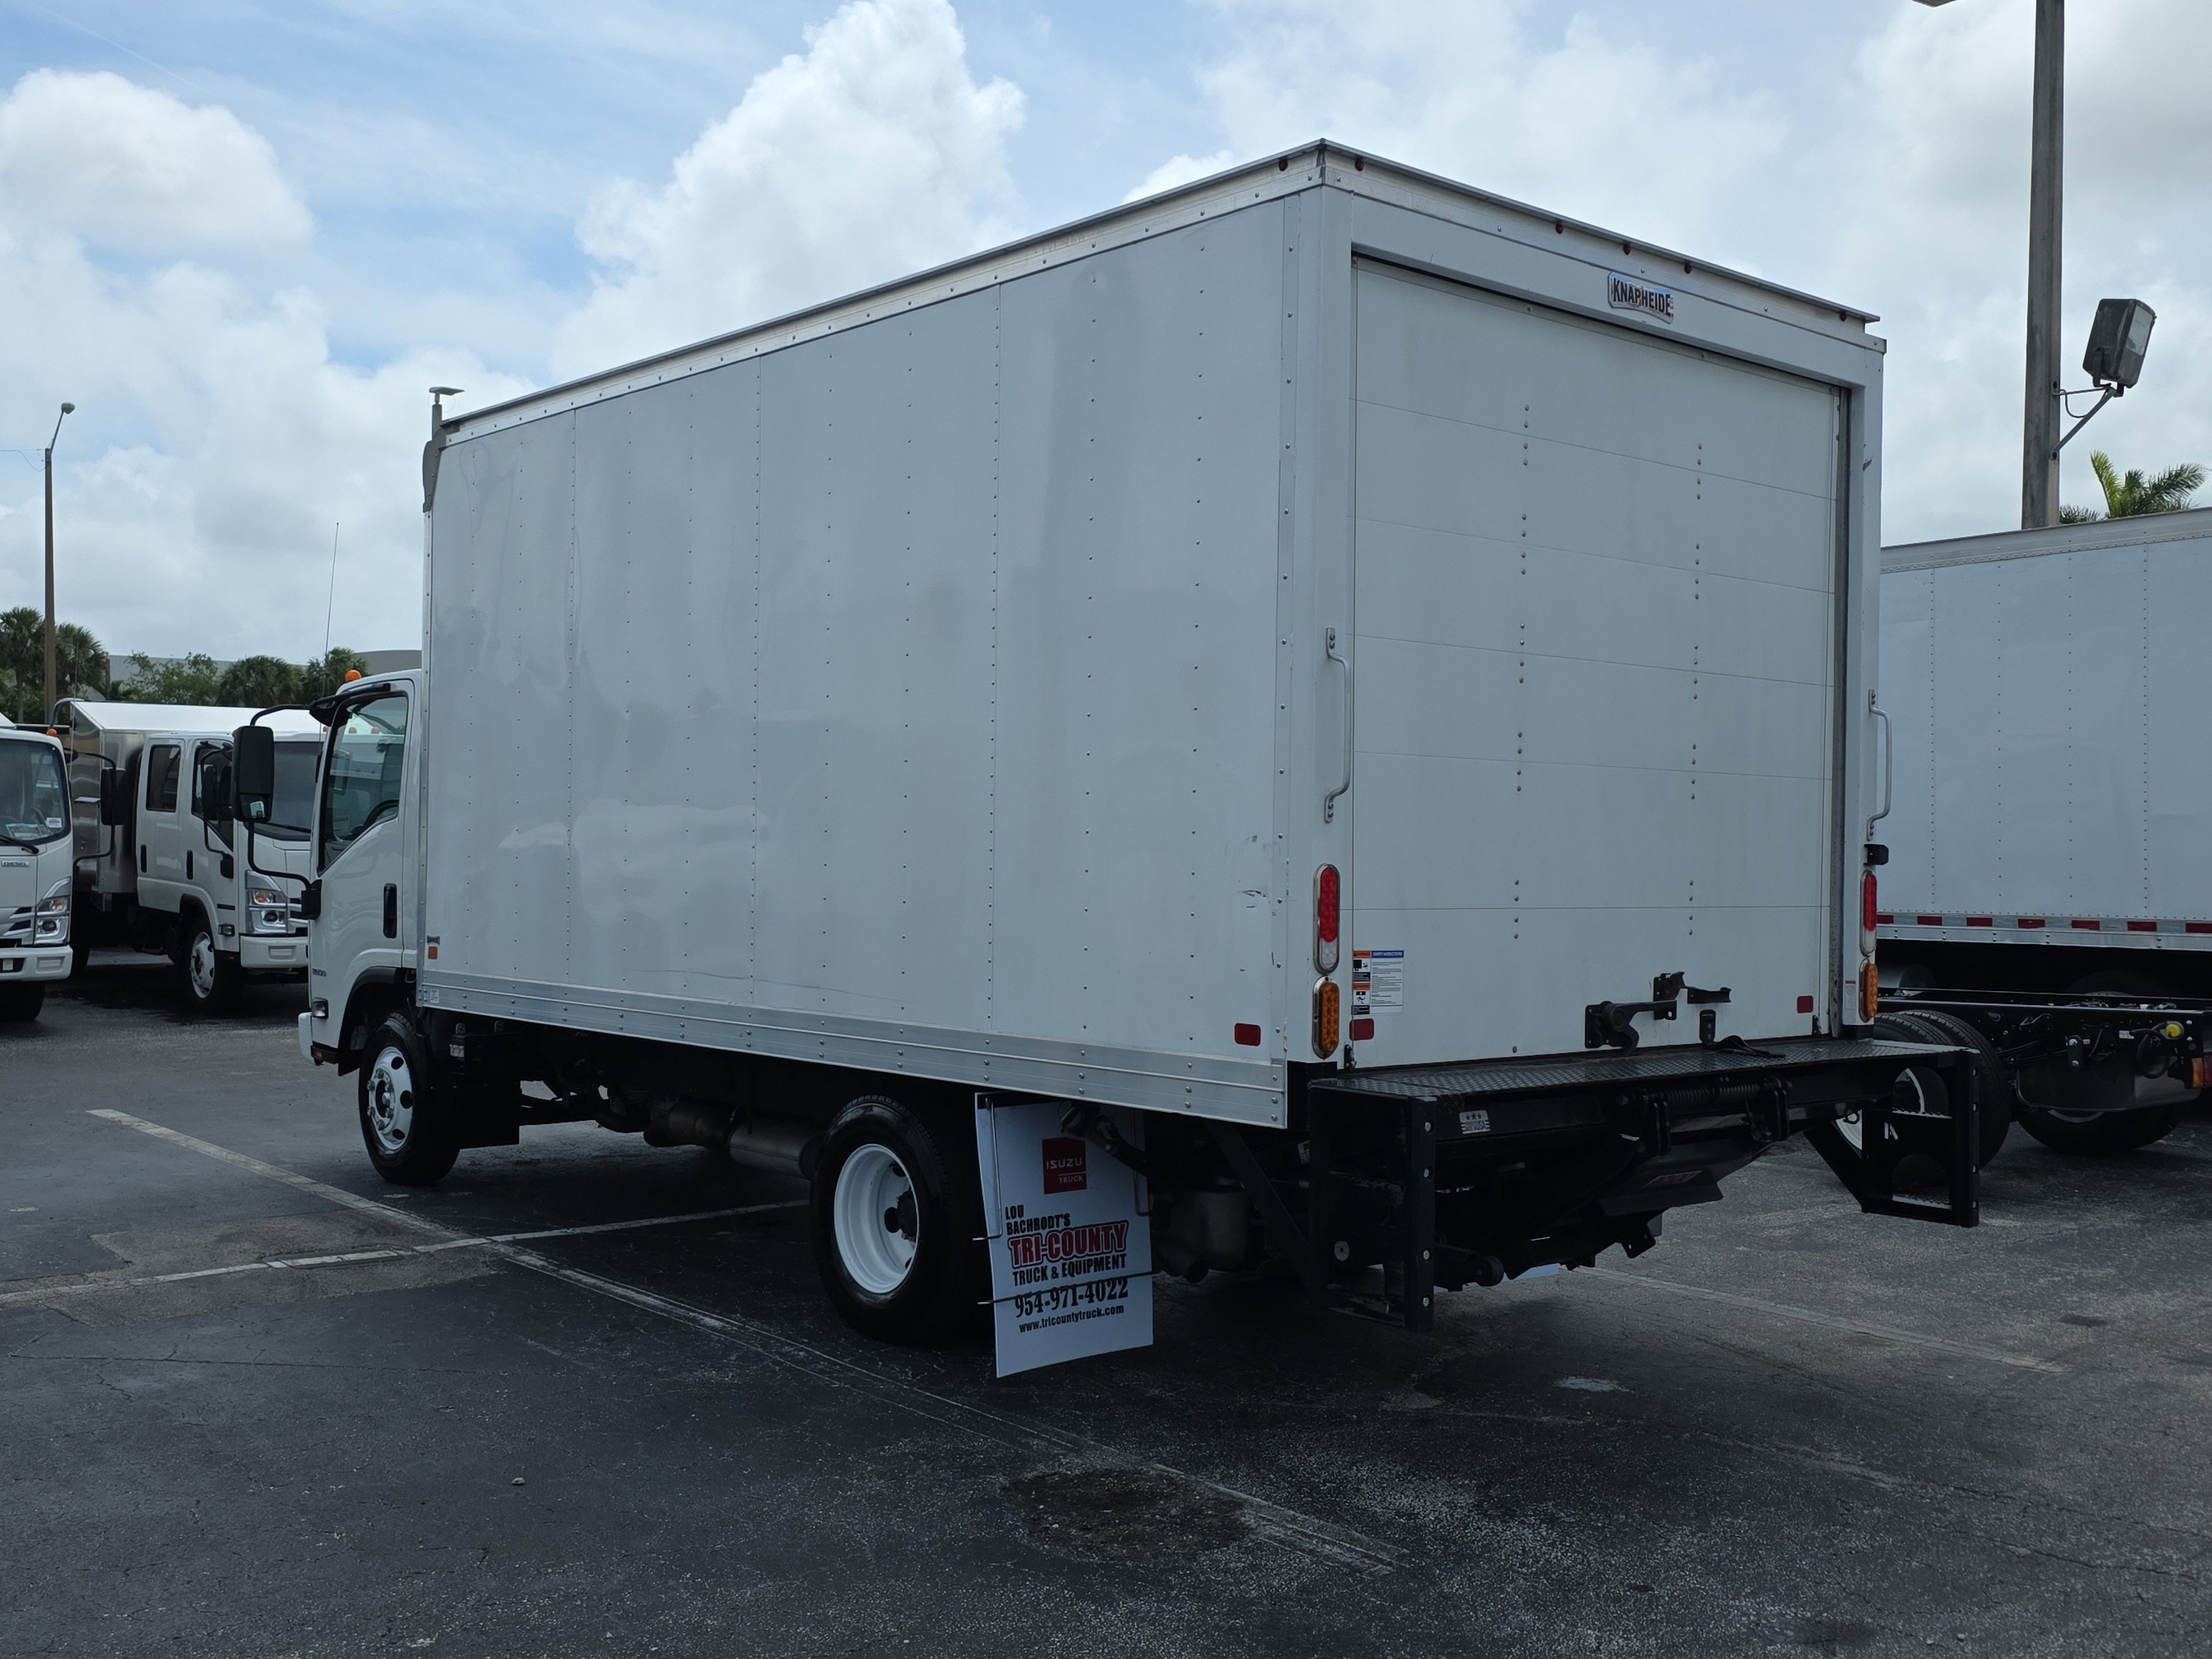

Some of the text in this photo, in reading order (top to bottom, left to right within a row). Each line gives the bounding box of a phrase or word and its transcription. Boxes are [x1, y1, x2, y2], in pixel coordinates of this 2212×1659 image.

[1612, 277, 1671, 318] KNAPHEIDE
[1046, 1156, 1083, 1170] ISUZU
[1058, 1174, 1084, 1184] TRUCK
[1005, 1204, 1024, 1220] LOU
[1006, 1213, 1071, 1235] BACHRODT'S
[1008, 1221, 1128, 1267] TRI-COUNTY
[1012, 1253, 1127, 1287] TRUCK & EQUIPMENT
[1014, 1278, 1129, 1318] 954-971-4022
[1019, 1304, 1124, 1333] www.tricountytruck.com
